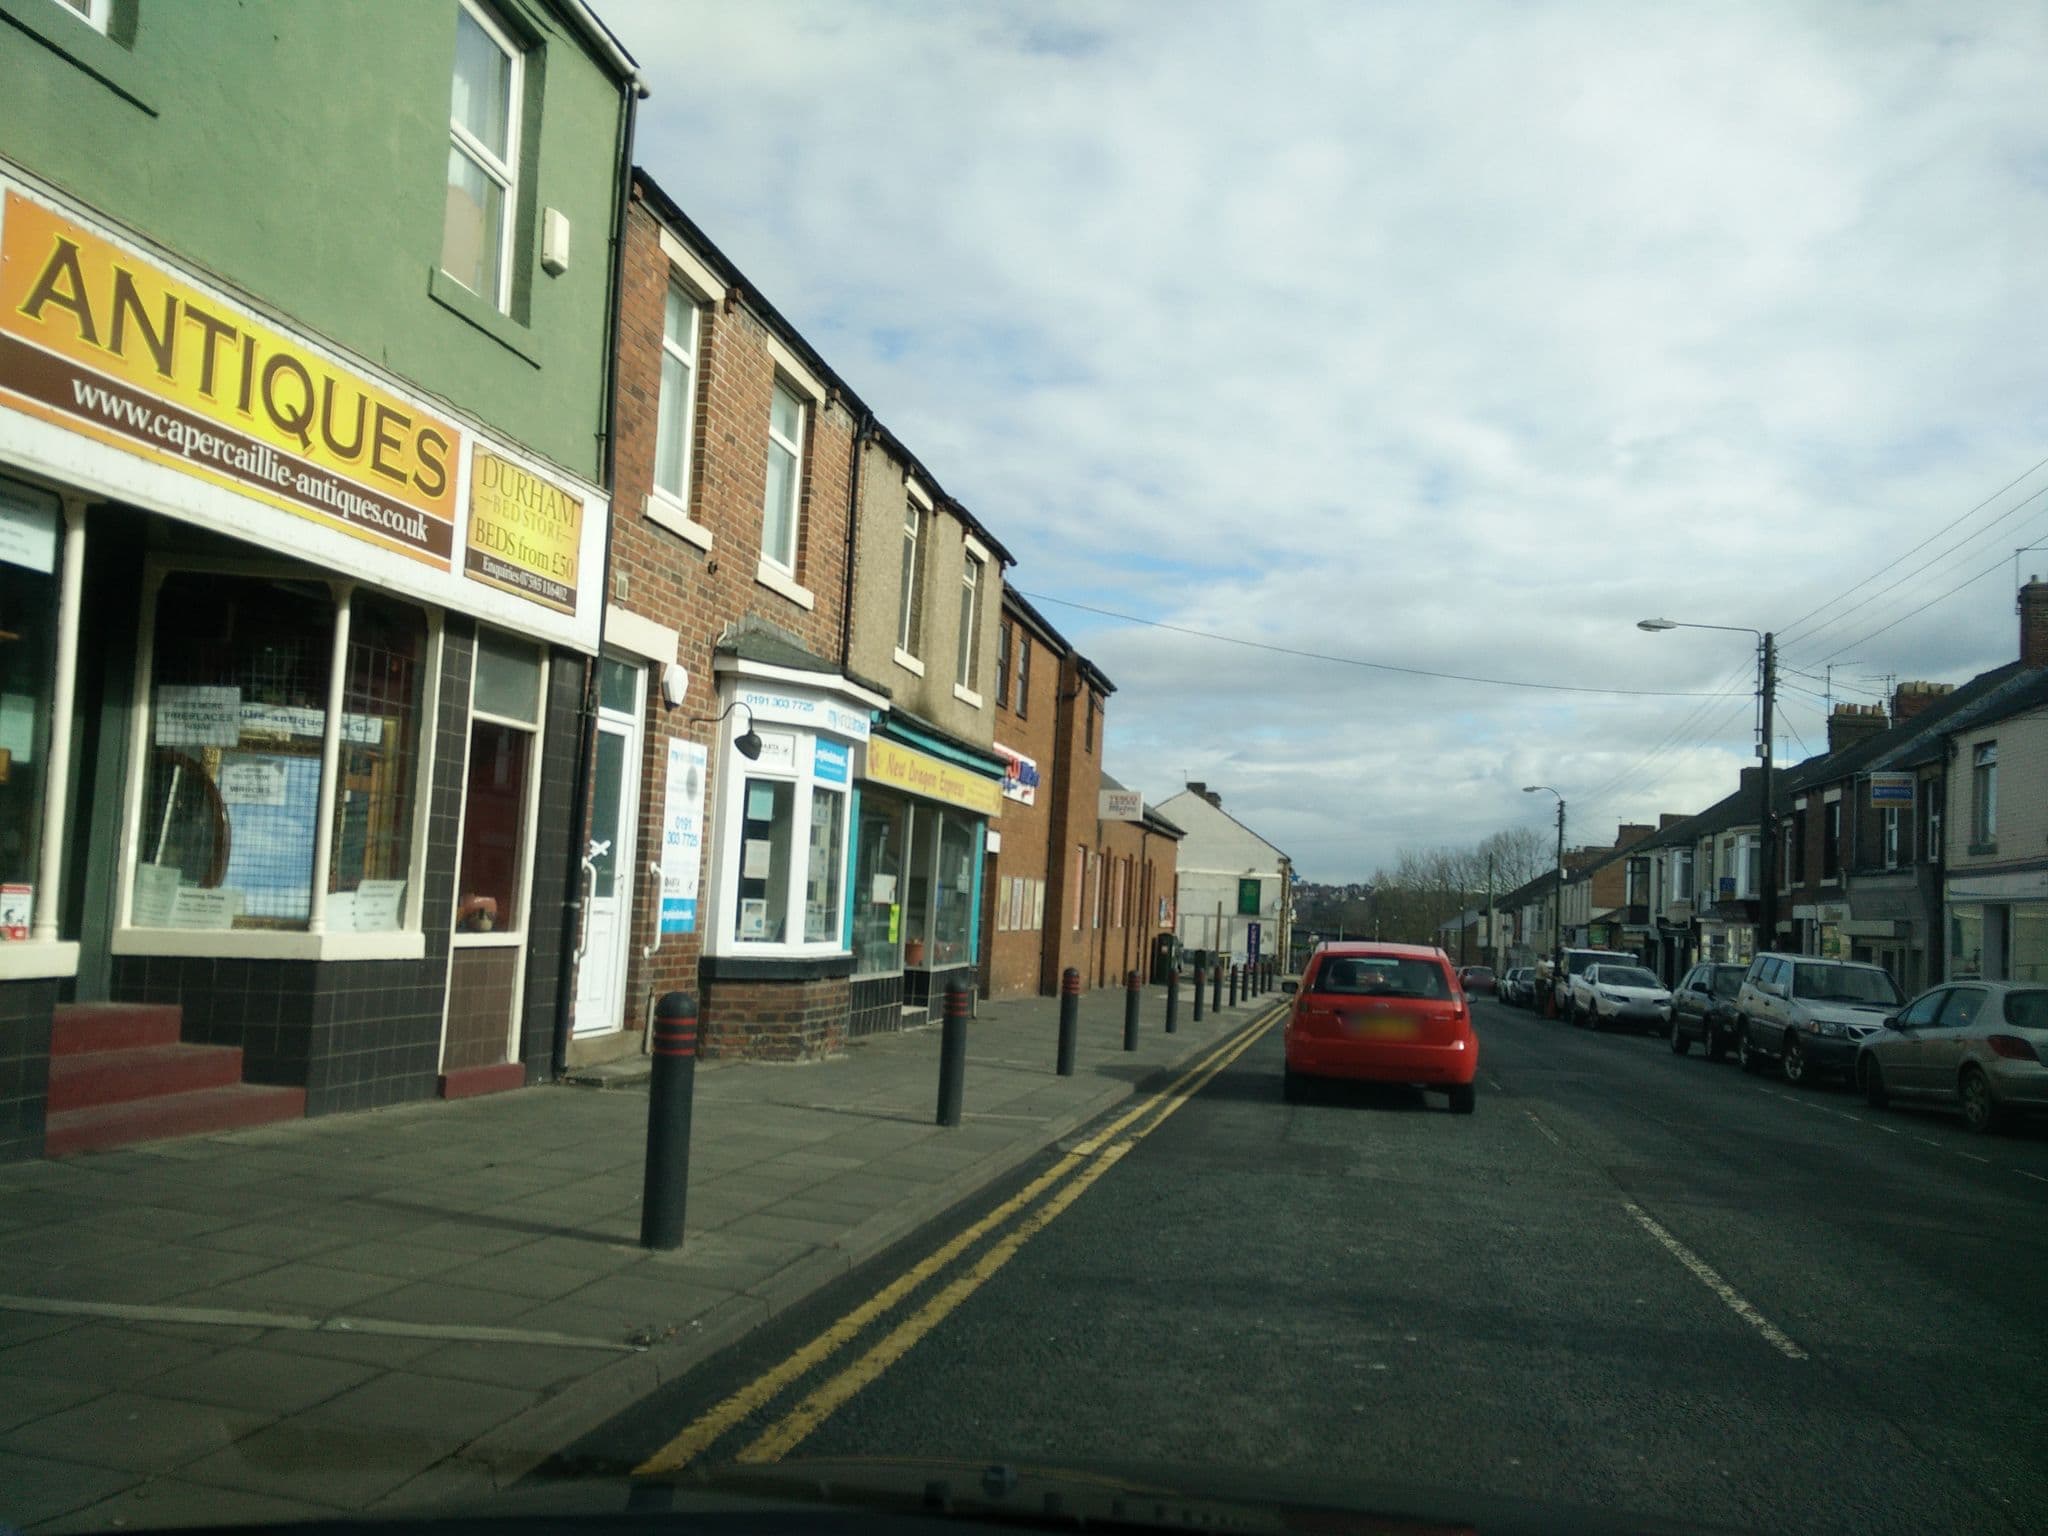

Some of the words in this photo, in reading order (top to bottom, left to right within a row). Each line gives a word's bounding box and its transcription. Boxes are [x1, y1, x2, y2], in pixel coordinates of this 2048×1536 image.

[17, 234, 450, 498] ANTIQUES
[72, 378, 429, 543] www.capercaillie-antiques.co.uk
[481, 454, 577, 528] DURHAM
[492, 495, 521, 523] BED
[523, 511, 562, 543] STORE
[475, 517, 516, 556] BEDS
[518, 536, 549, 571] from
[552, 552, 574, 580] £50
[482, 555, 520, 584] Enquiries
[164, 711, 234, 722] FIREPLACES
[746, 694, 769, 705] 0191
[887, 752, 905, 776] New
[908, 759, 937, 792] Dragon
[939, 770, 965, 799] Express
[206, 893, 225, 901] Times
